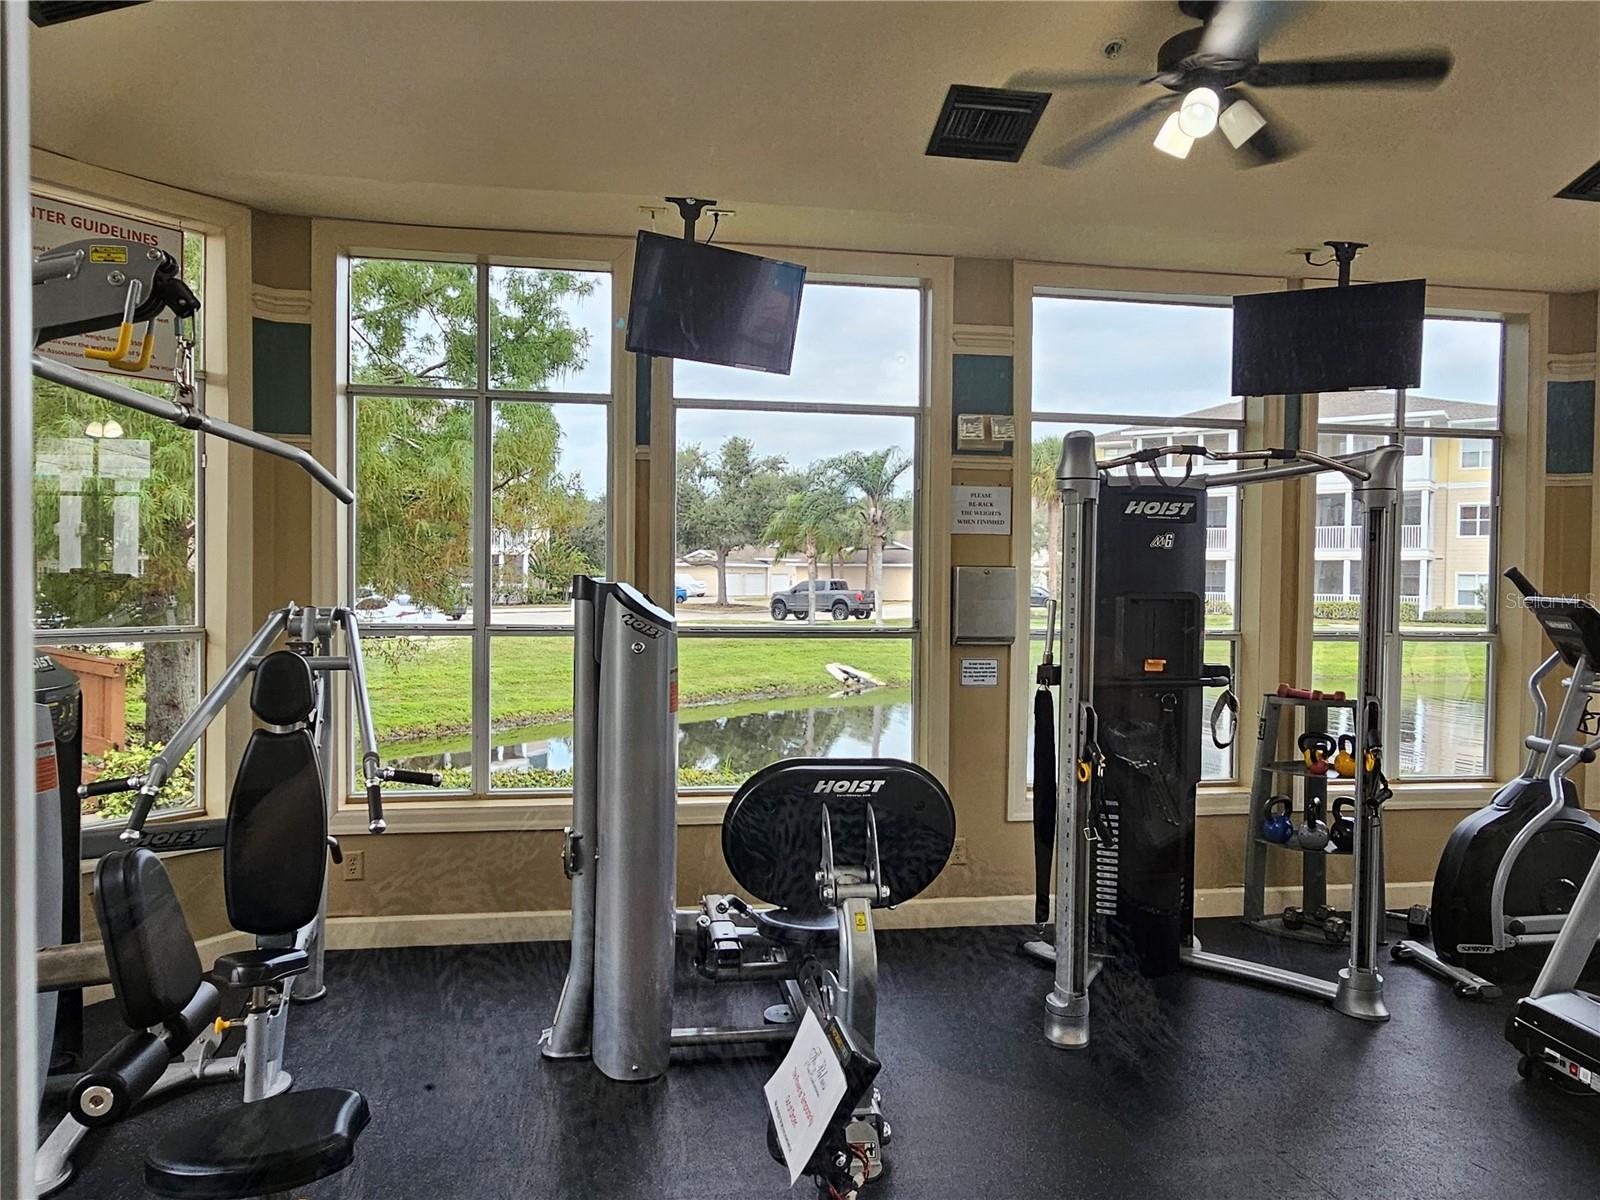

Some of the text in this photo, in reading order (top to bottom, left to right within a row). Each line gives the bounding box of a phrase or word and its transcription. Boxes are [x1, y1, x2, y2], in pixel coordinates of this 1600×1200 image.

[71, 216, 159, 246] GUIDELINES
[1124, 500, 1195, 516] HOIST
[621, 613, 665, 639] HOIST
[812, 780, 886, 794] HOIST
